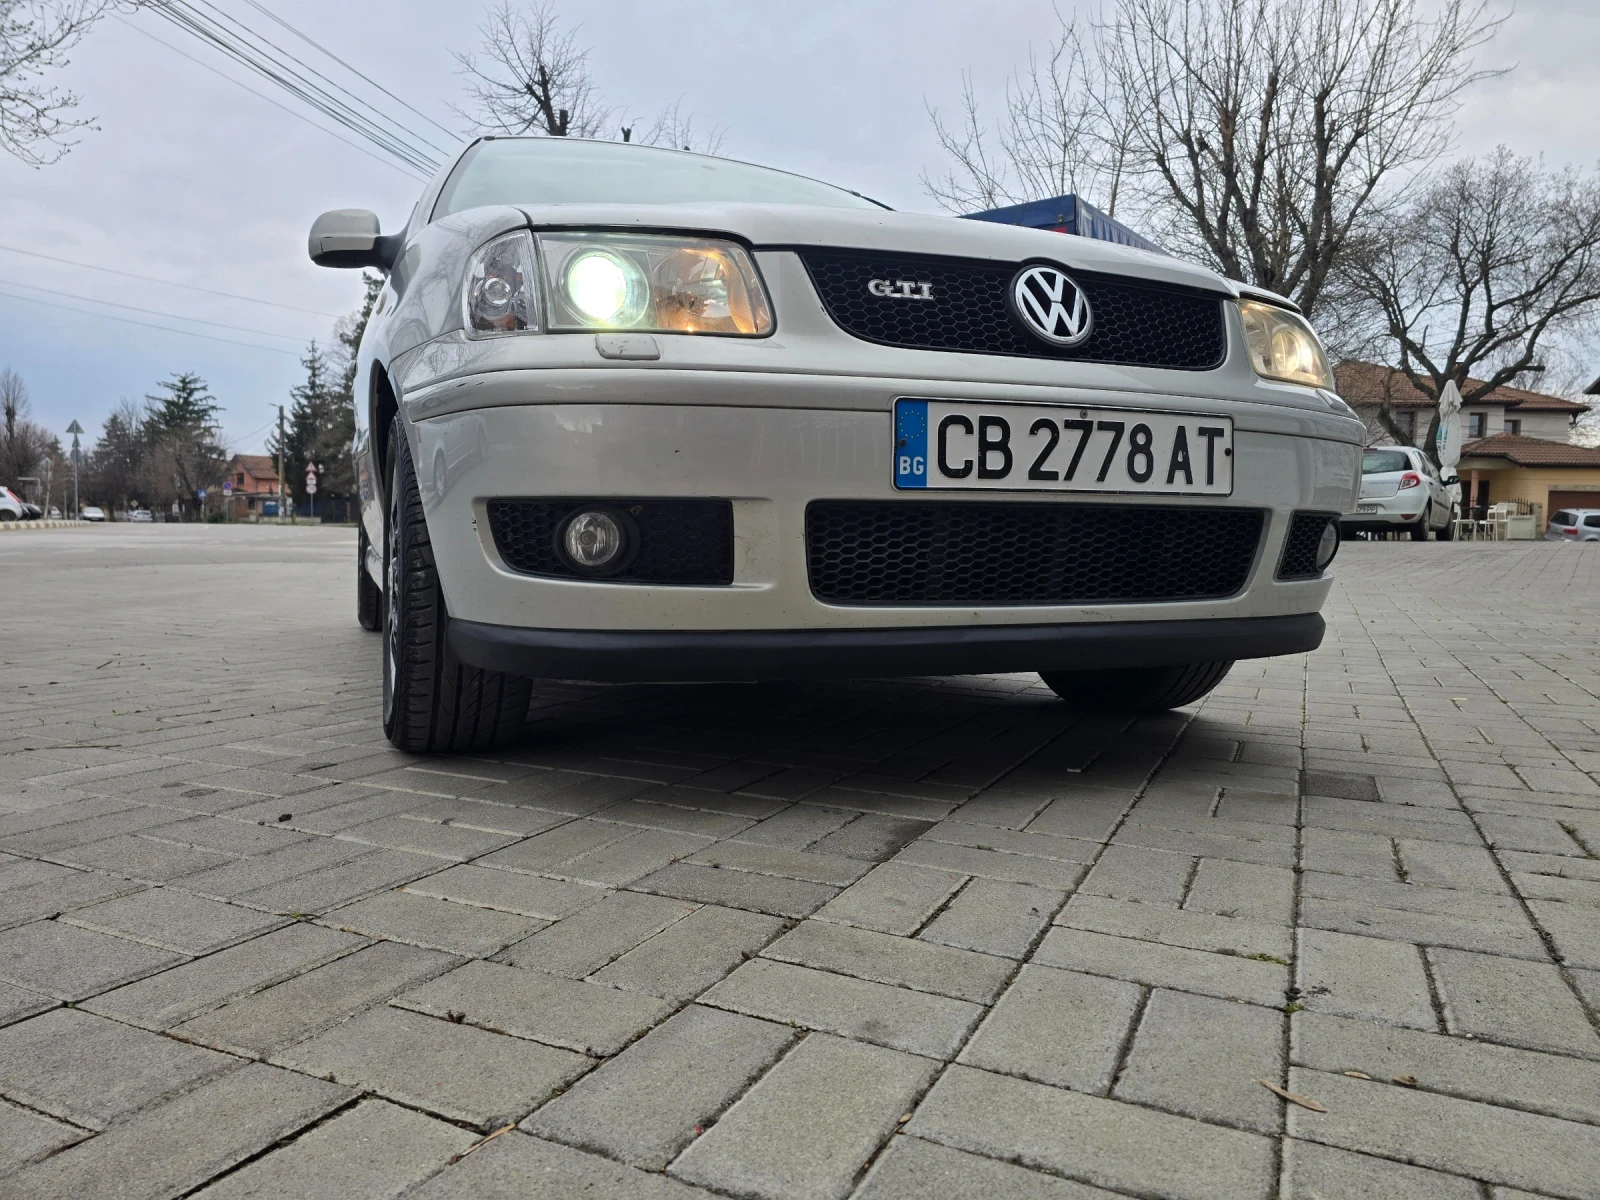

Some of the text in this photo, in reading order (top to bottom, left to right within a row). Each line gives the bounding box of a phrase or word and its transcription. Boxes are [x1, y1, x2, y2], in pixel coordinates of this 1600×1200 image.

[867, 279, 934, 300] GTI
[937, 414, 1225, 485] CB 2778 AT
[899, 456, 924, 475] BG
